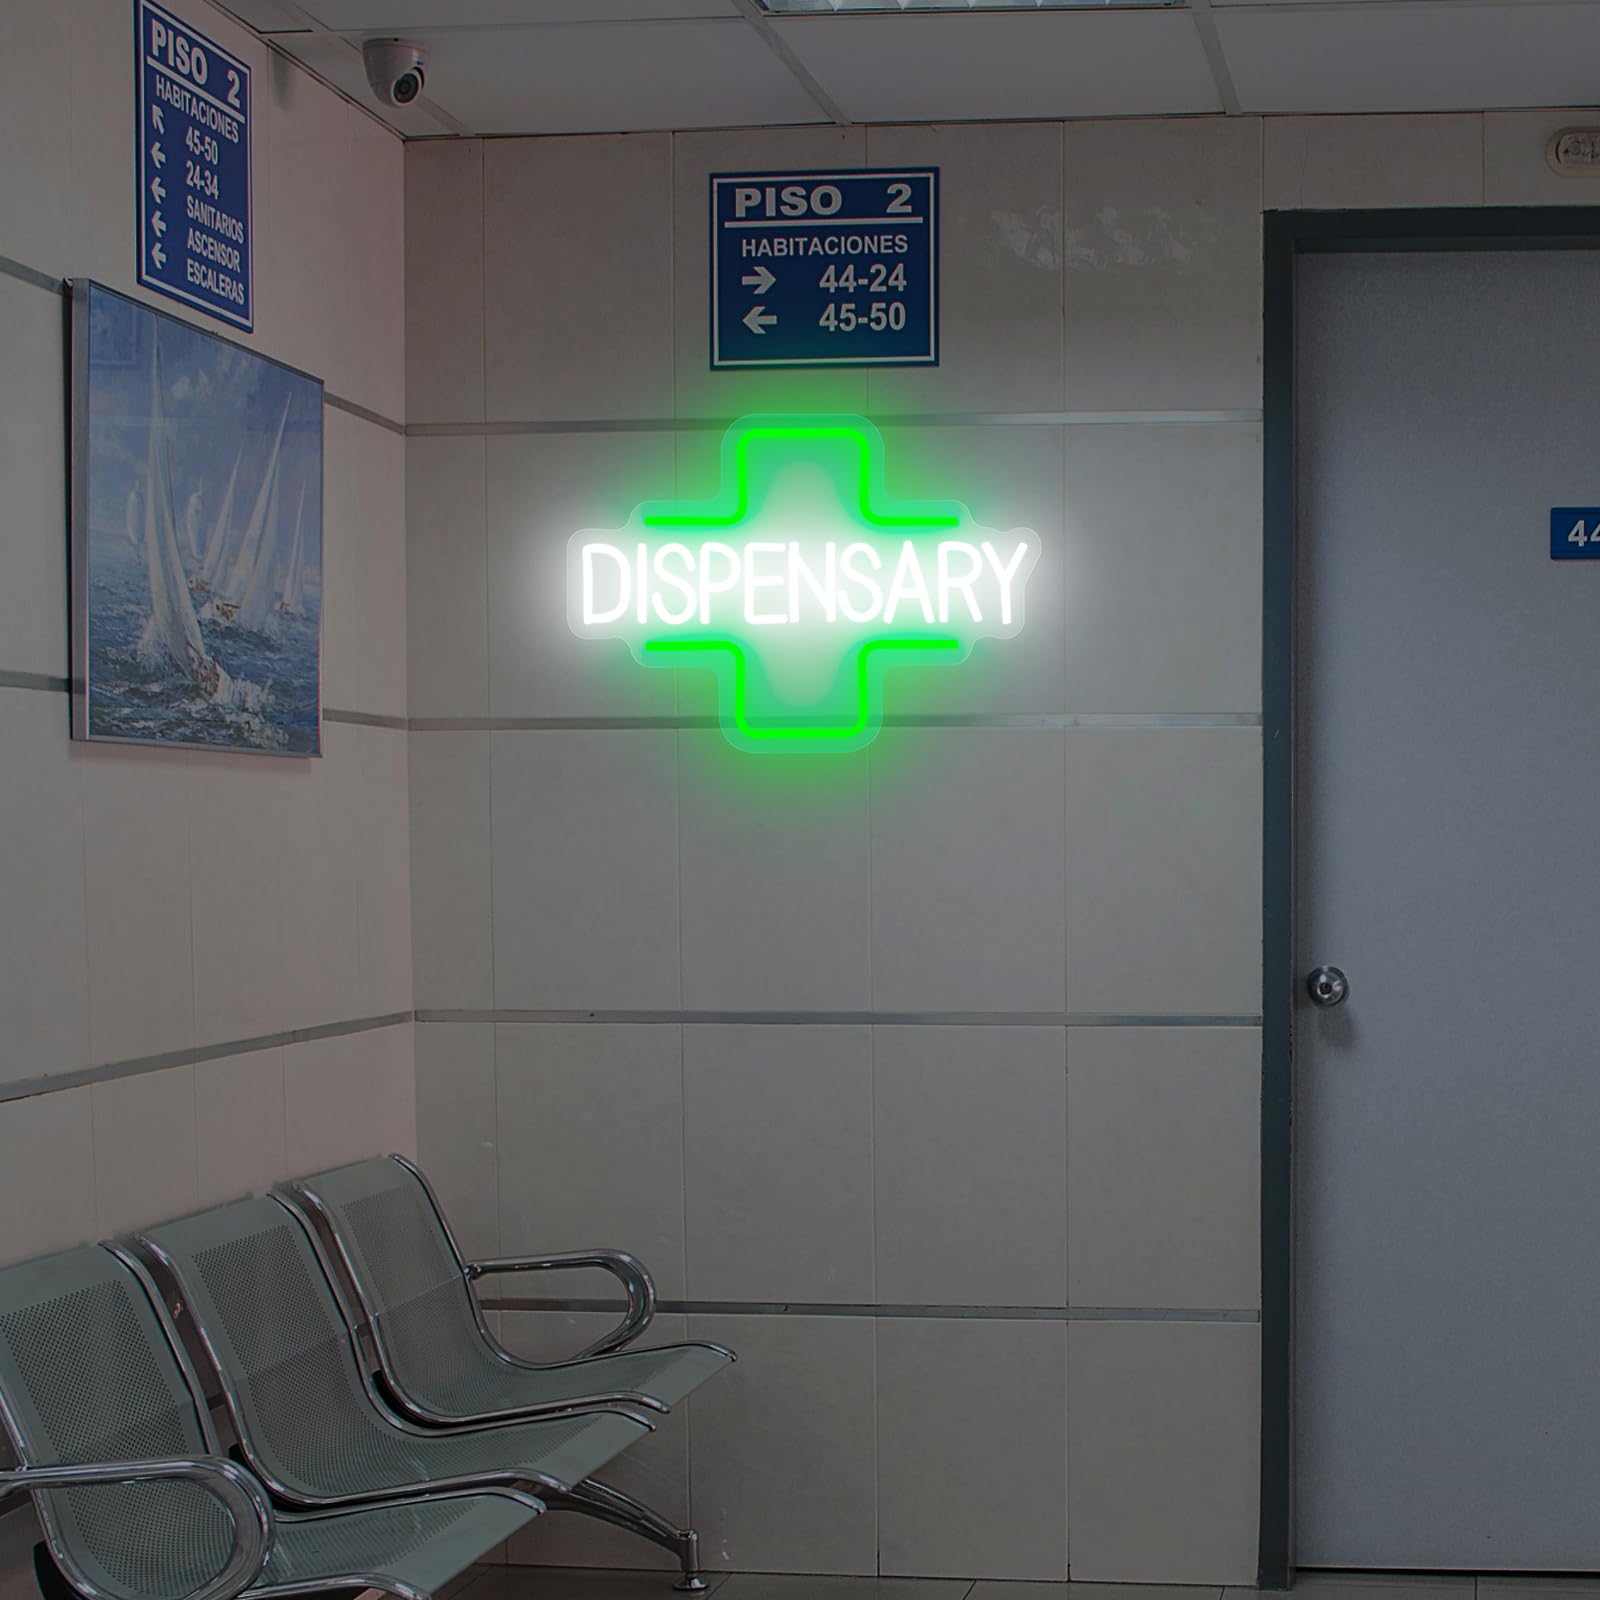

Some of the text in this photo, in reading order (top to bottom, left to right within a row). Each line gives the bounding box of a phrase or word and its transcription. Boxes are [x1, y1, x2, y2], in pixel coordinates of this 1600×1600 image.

[151, 18, 241, 108] PISO 2
[155, 74, 239, 144] HABITACIONES
[185, 125, 218, 165] 45-50
[186, 160, 219, 200] 24-34
[735, 183, 912, 218] PISO 2
[186, 195, 244, 244] SANITARIOS
[187, 228, 240, 273] ASCENSOR
[742, 235, 908, 257] HABITACIONES
[187, 259, 244, 305] ESCALERAS
[819, 263, 907, 293] 44-24
[819, 302, 906, 332] 45-50
[582, 540, 1028, 625] DISPENSARY
